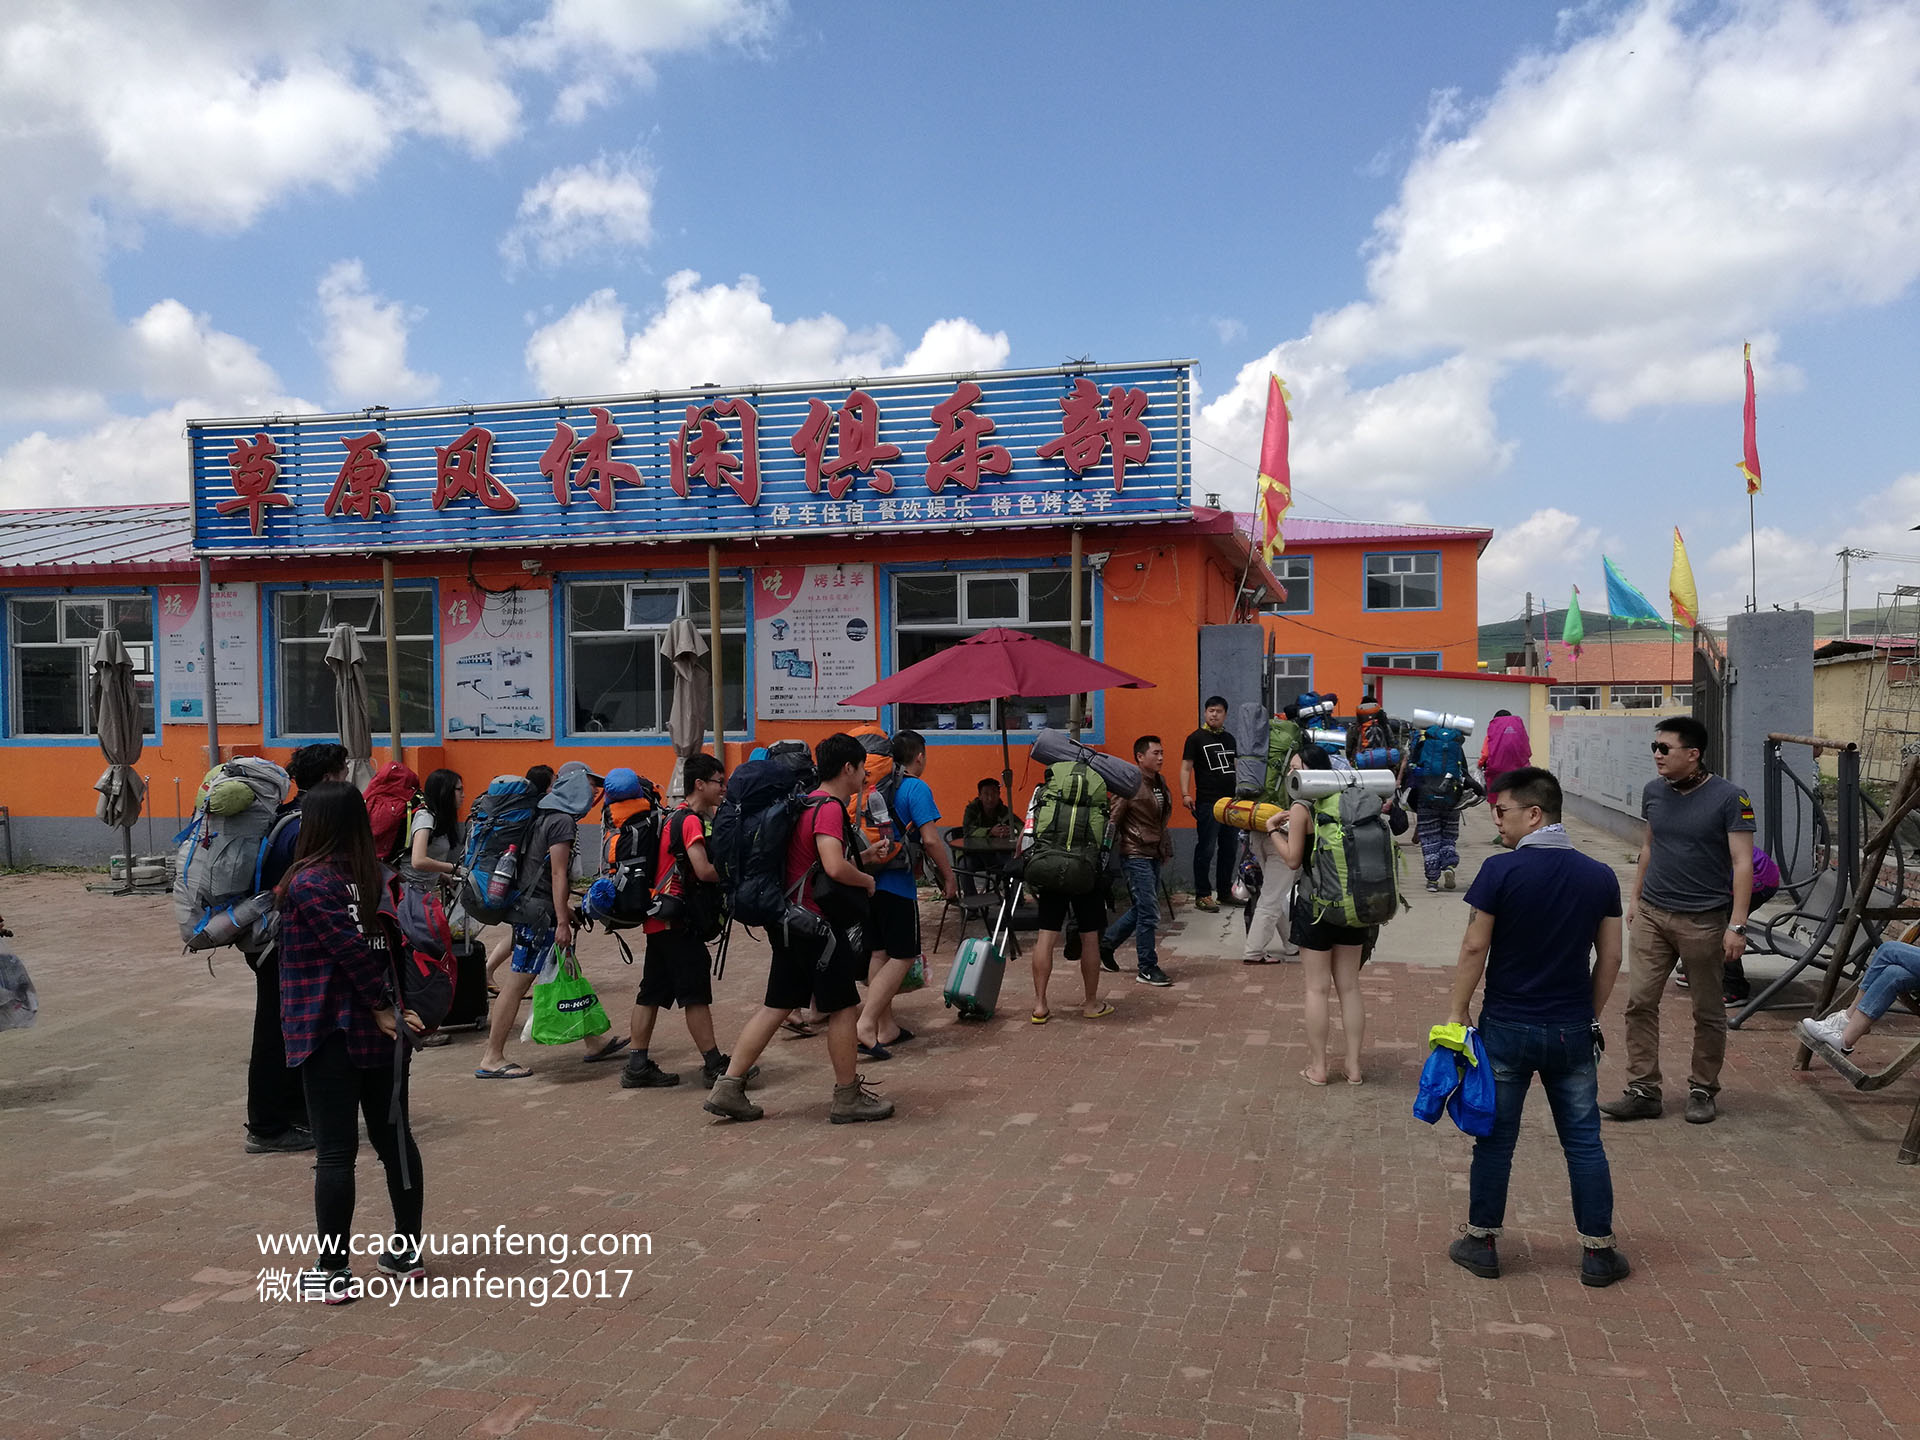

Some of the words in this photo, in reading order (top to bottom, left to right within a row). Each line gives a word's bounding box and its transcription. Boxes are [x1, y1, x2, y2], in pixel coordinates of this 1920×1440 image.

[216, 378, 1152, 536] 草原风休闲俱乐部
[771, 504, 865, 526] 停车住宿
[878, 497, 974, 520] 餐饮娱乐
[991, 490, 1113, 514] 特色烤全羊
[761, 570, 792, 601] 吃
[448, 599, 472, 627] 住
